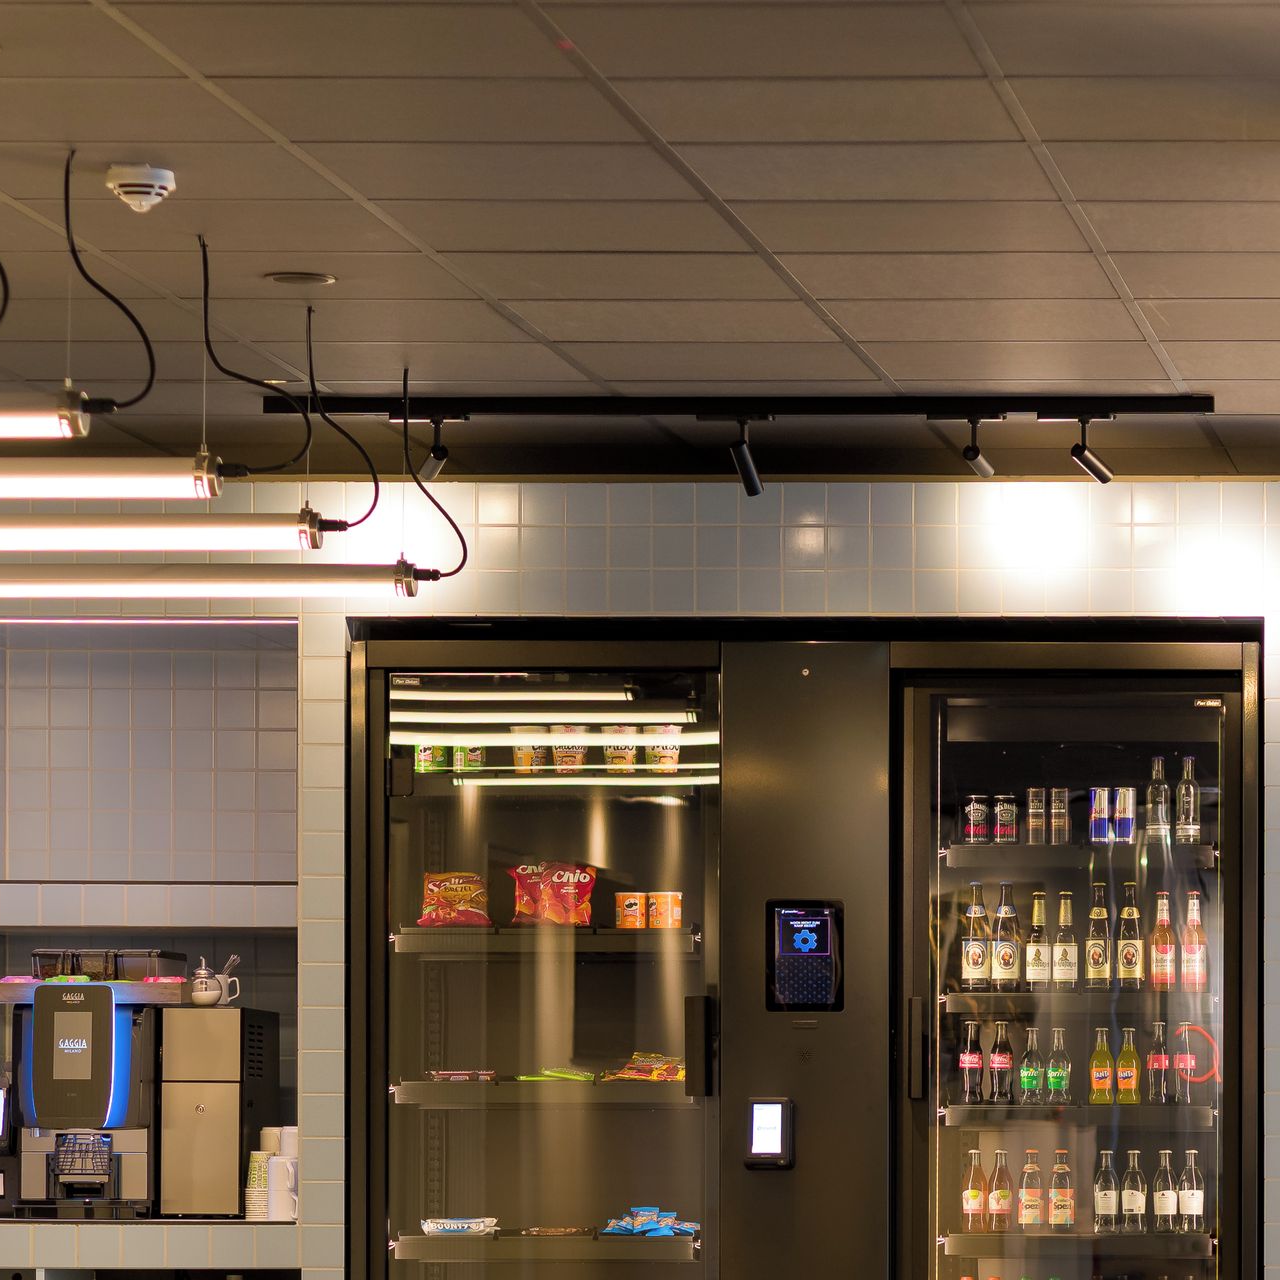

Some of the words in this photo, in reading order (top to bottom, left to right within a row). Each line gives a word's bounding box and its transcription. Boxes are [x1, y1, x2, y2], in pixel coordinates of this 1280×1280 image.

[551, 869, 591, 883] Chio
[58, 1038, 88, 1049] GAGGIA
[1020, 1068, 1039, 1077] Sprite
[1047, 1068, 1067, 1077] Sprite
[431, 1222, 469, 1230] BOUNTY
